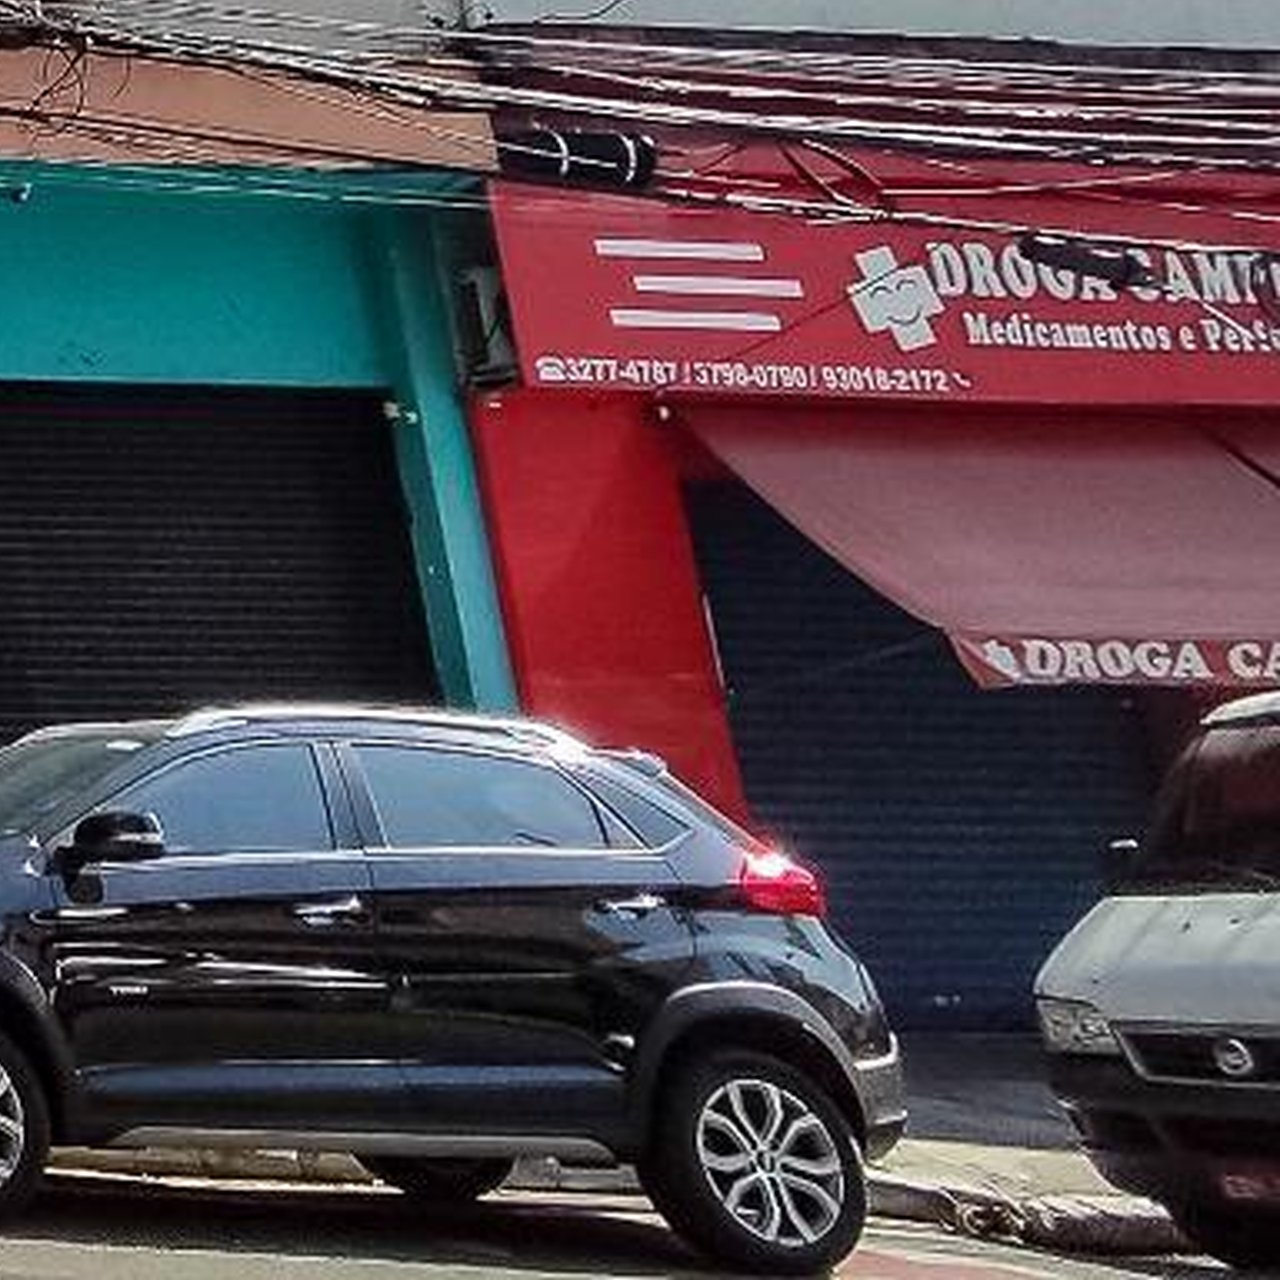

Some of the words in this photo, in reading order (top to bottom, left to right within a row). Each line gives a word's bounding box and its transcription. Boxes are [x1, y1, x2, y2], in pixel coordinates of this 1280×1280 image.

[963, 312, 1172, 352] Medicamentos
[1179, 325, 1197, 351] e
[1022, 638, 1214, 679] DROGA
